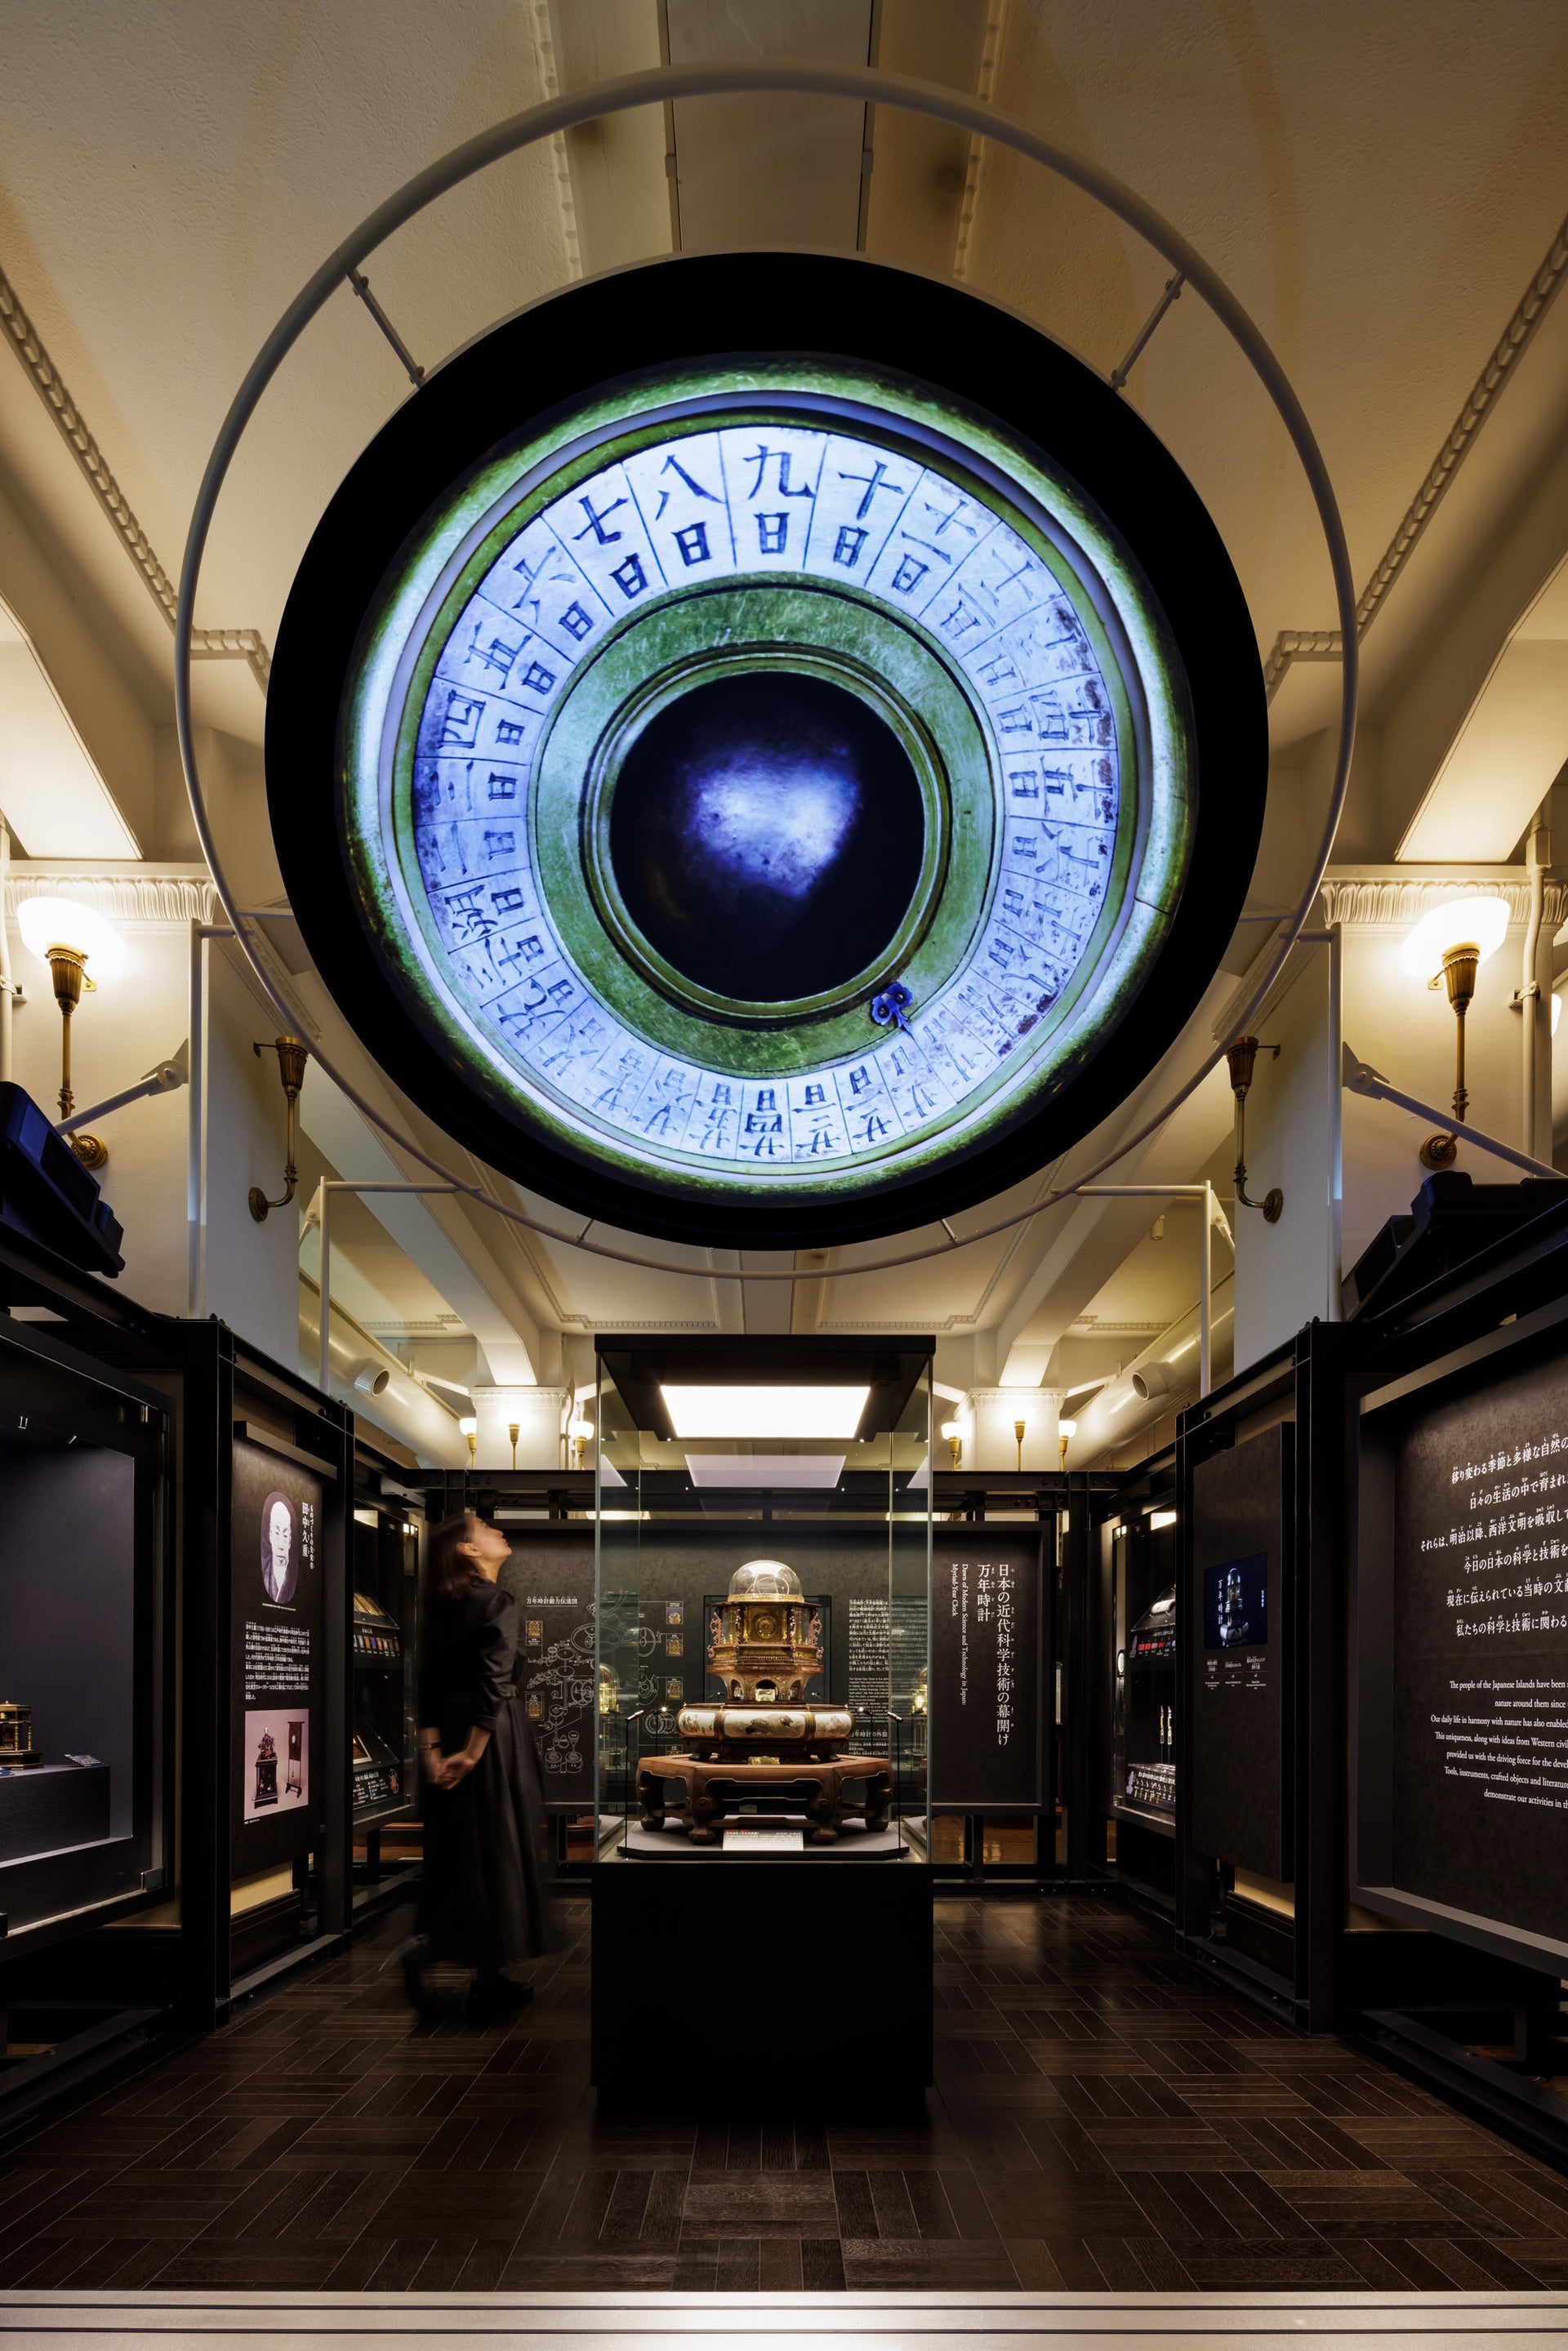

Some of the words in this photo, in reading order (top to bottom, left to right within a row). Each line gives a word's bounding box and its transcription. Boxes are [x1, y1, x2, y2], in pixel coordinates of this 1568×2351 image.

[657, 455, 724, 566] 八日
[743, 444, 815, 554] 九日
[834, 461, 903, 567] 十日
[572, 495, 648, 599] 七日
[893, 500, 978, 595] 十一日
[513, 547, 594, 641] 六日
[942, 549, 1034, 639] 十二日
[465, 621, 556, 694] 五日
[438, 689, 523, 748] 四日
[998, 689, 1102, 741] 十四日
[430, 755, 517, 812] 三日
[1009, 755, 1113, 819] 十五日
[1470, 1473, 1568, 1510] 日々の生活の中で育まれ
[951, 1564, 959, 1598] Myriad-Year
[978, 1564, 991, 1622] 万年時計
[1456, 1614, 1568, 1637] 私たちの科学と技術に関わる
[960, 1646, 969, 1680] Technology
[996, 1564, 1011, 1746] 日本の近代科学技術の幕開け
[960, 1687, 969, 1705] Japan:
[1450, 1681, 1459, 1689] The
[1459, 1681, 1475, 1690] people
[1477, 1681, 1482, 1689] of
[1483, 1681, 1491, 1689] the
[1492, 1681, 1514, 1690] Japanese
[1516, 1680, 1535, 1689] Islands
[1536, 1679, 1549, 1688] have
[1552, 1679, 1565, 1688] been
[1512, 1699, 1532, 1707] around
[1534, 1699, 1548, 1708] them
[1551, 1699, 1566, 1708] since
[1441, 1715, 1452, 1725] daily
[1468, 1716, 1490, 1726] harmony
[1491, 1717, 1503, 1725] with
[1523, 1718, 1532, 1726] has
[1534, 1718, 1544, 1727] also
[1446, 1733, 1472, 1743] uniqueness,
[1474, 1734, 1488, 1744] along
[1502, 1736, 1515, 1744] ideas
[1516, 1736, 1530, 1745] from
[1531, 1738, 1555, 1748] Western
[1445, 1766, 1459, 1776] Tools,
[1459, 1769, 1489, 1779] instruments,
[1491, 1772, 1508, 1781] crafted
[1510, 1773, 1529, 1784] objects
[1530, 1776, 1541, 1785] and
[1447, 1751, 1467, 1759] provided
[1475, 1752, 1486, 1761] with
[1497, 1754, 1516, 1765] driving
[1517, 1756, 1530, 1765] force
[1532, 1757, 1541, 1765] for
[1543, 1757, 1552, 1766] the
[1484, 1789, 1516, 1801] demonstrate
[1529, 1797, 1553, 1806] activities
[1555, 1799, 1561, 1807] in
